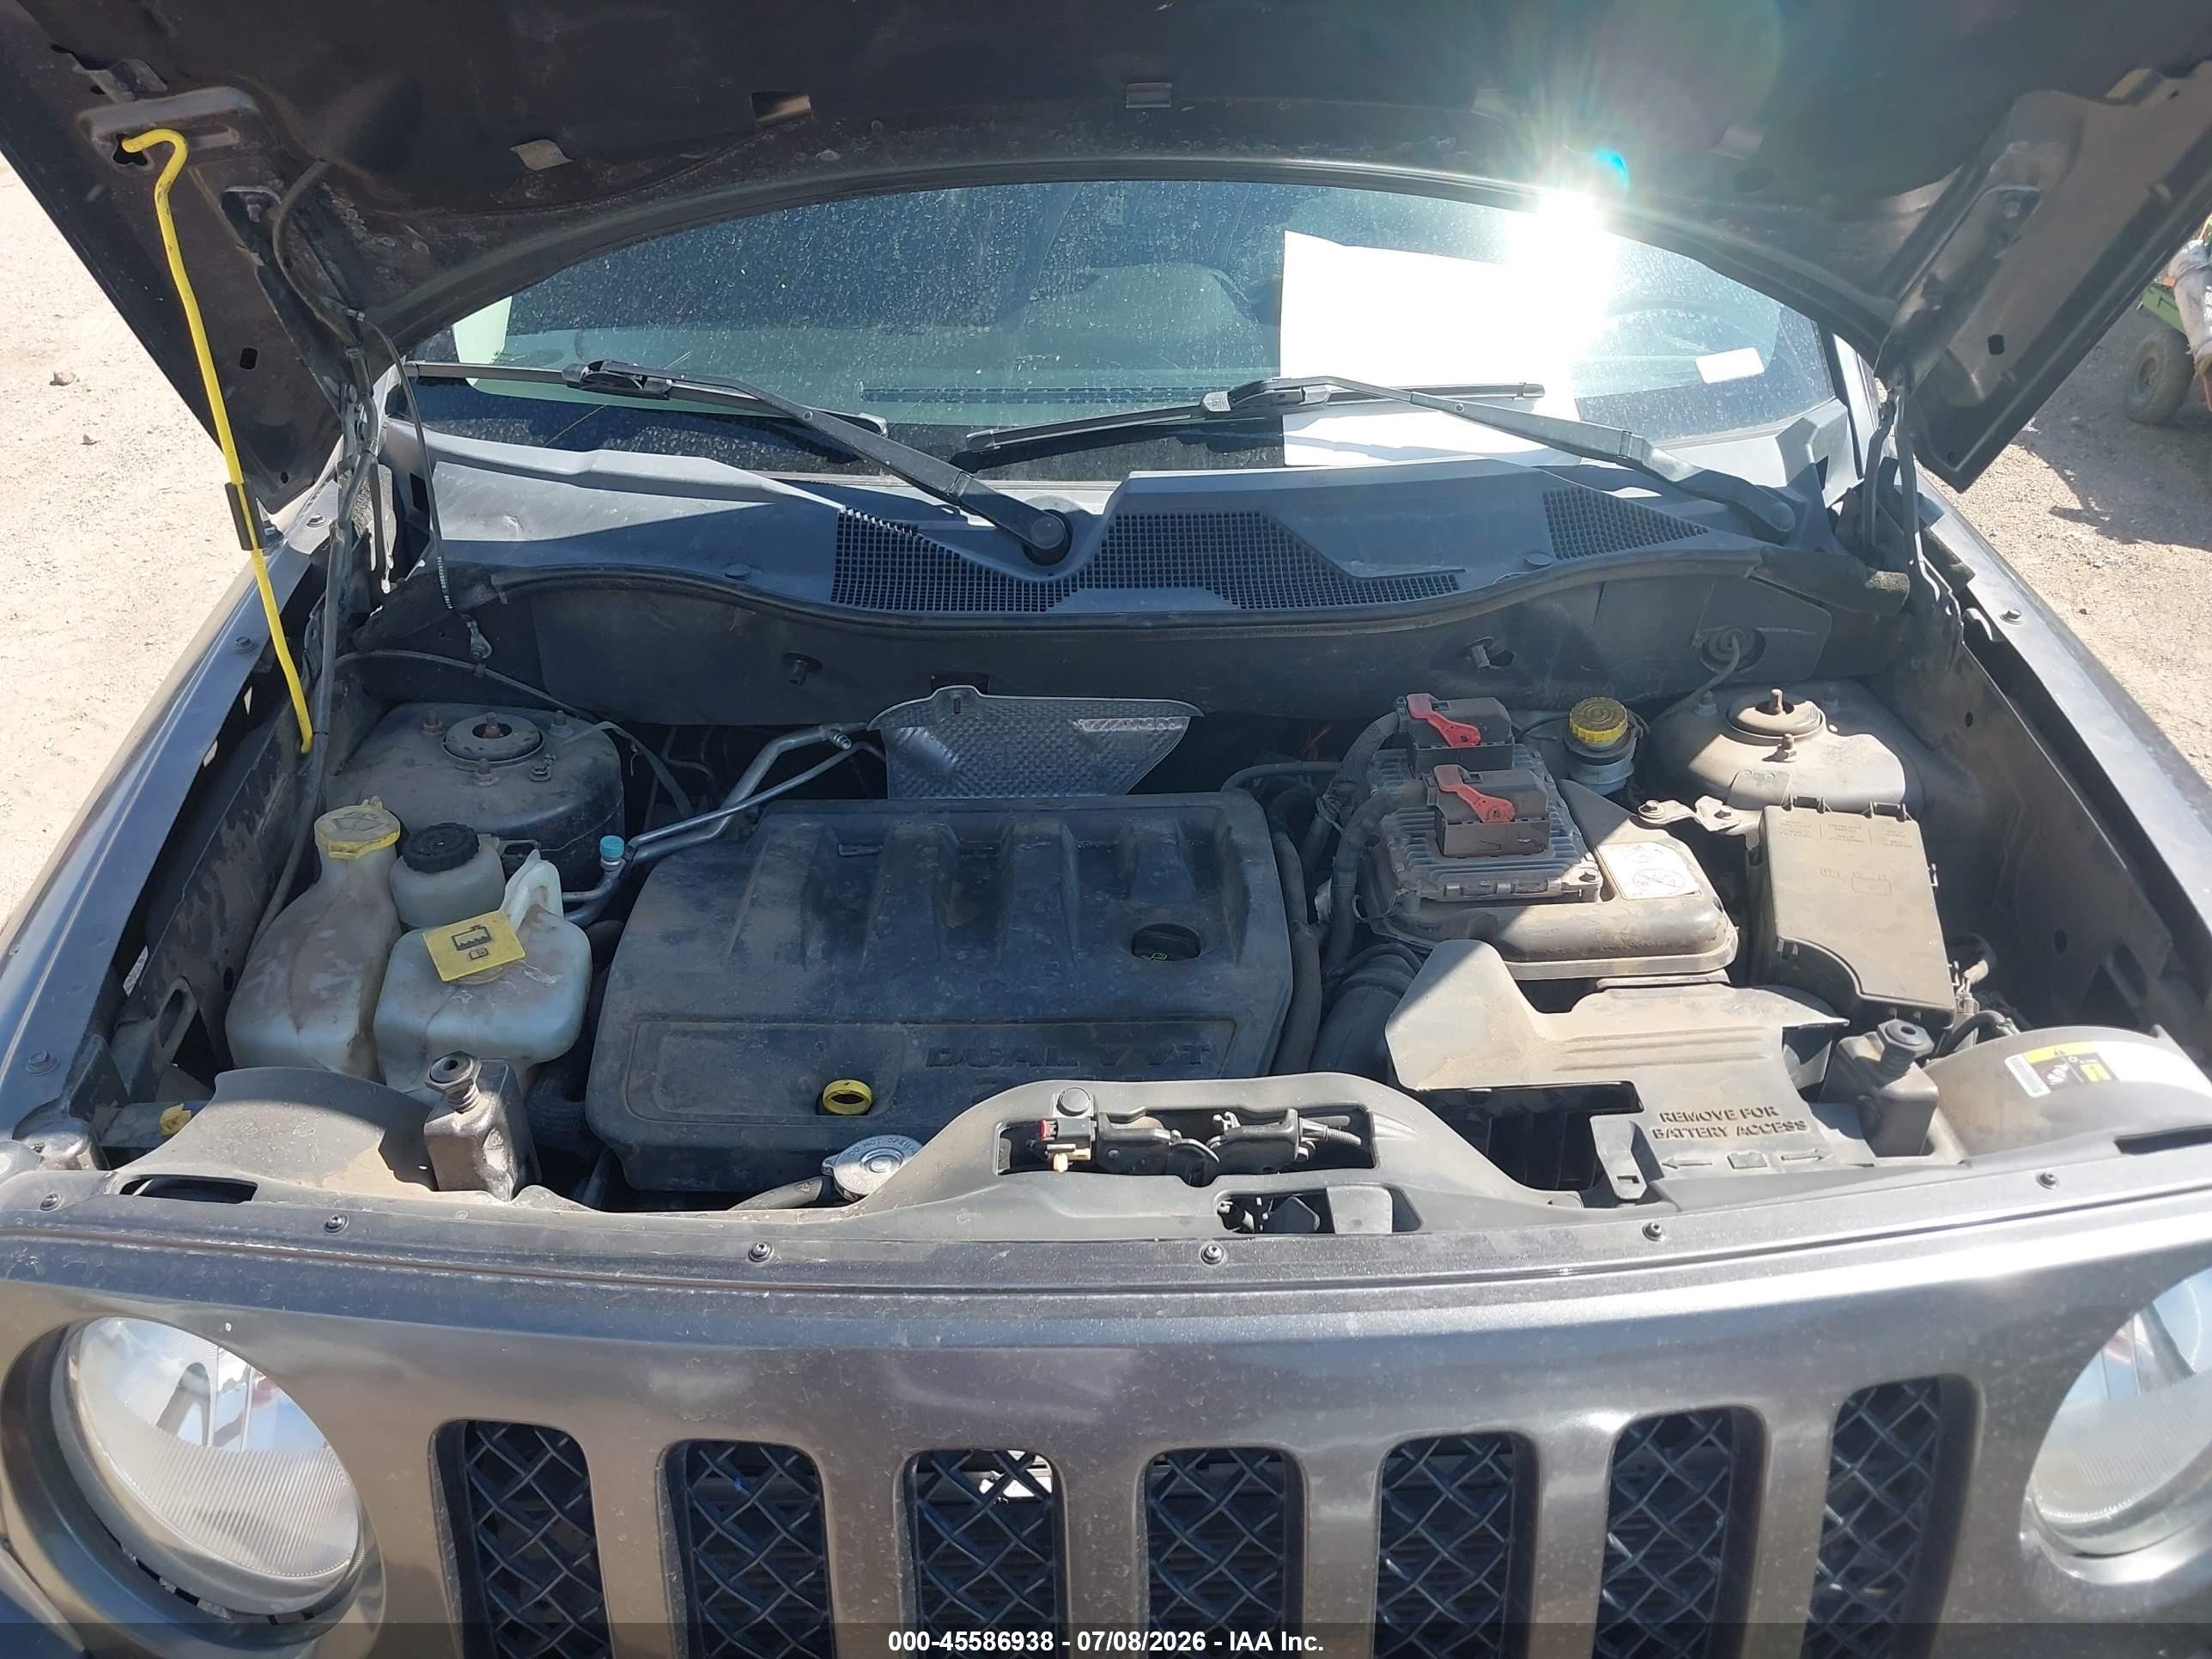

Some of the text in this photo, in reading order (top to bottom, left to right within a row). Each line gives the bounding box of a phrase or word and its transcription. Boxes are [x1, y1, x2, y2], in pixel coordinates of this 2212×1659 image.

[926, 1047, 1079, 1068] DUAL
[1659, 1105, 1779, 1123] REMOVE FOR
[1652, 1121, 1807, 1140] BATTERY ACCESS
